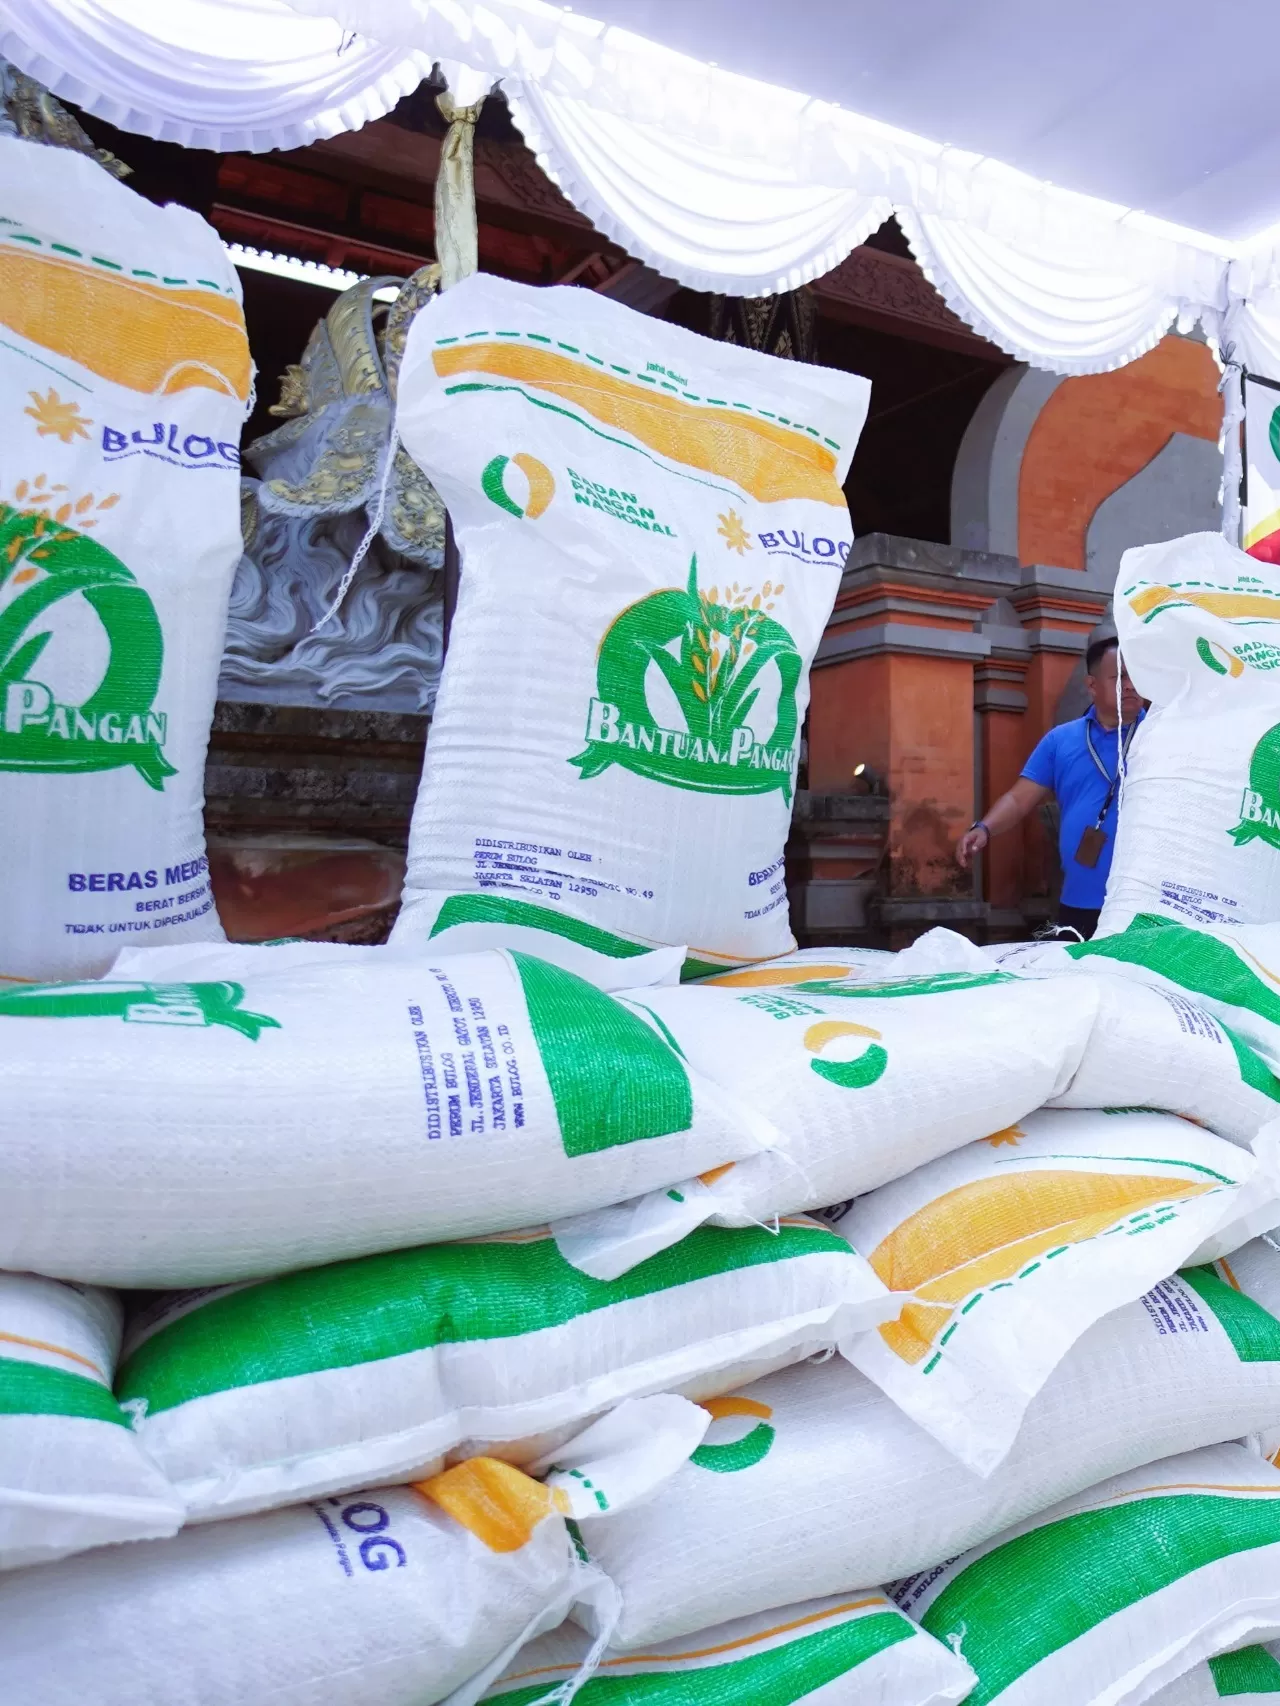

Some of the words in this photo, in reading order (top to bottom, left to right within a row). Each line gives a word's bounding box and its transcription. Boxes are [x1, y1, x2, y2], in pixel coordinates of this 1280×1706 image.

[102, 422, 241, 464] BULOG
[566, 467, 638, 505] BADAN
[570, 479, 656, 520] PANGAN
[574, 492, 679, 538] NASIONAL
[5, 680, 168, 746] PANGAN
[588, 697, 722, 765] BANTUAN
[728, 726, 797, 775] PANGAN
[475, 838, 562, 857] DIDISTRIBUSIKAN
[67, 870, 158, 892] BERAS
[165, 857, 210, 886] MED
[519, 874, 563, 889] SELATAN
[568, 882, 598, 897] 12950
[136, 897, 175, 912] BERAT
[65, 922, 104, 935] TIDAK
[109, 919, 151, 933] UNTUK
[468, 997, 487, 1021] 12950
[476, 1025, 498, 1069] SELATAN
[414, 1030, 442, 1140] DIDISTRIBUSIKAN
[440, 1052, 459, 1089] BULOG
[448, 1094, 463, 1137] PERUM
[488, 1075, 507, 1131] JAKARTA
